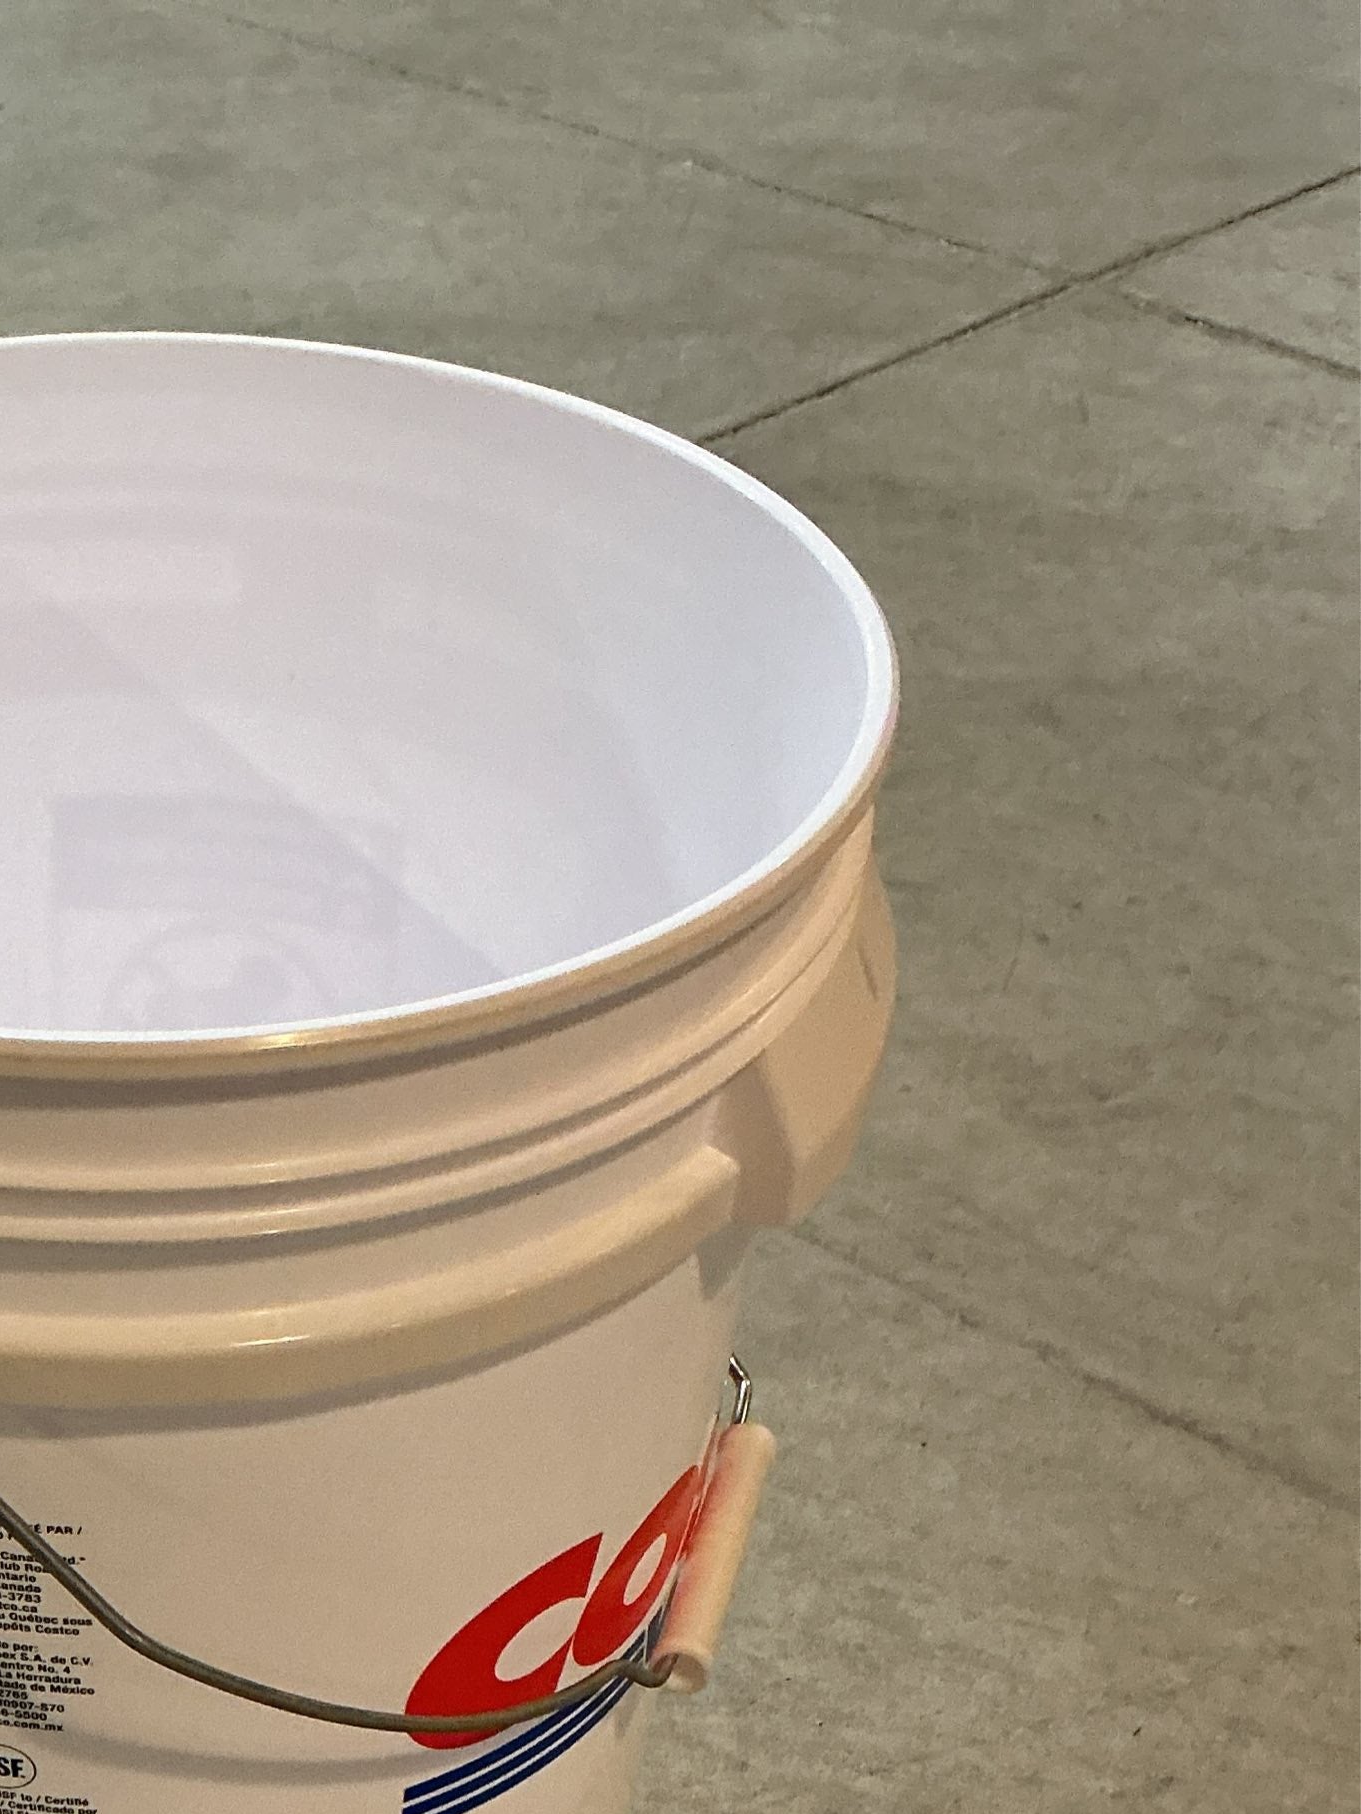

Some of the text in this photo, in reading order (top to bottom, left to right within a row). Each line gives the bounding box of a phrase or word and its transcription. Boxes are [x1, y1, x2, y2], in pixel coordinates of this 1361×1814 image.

[47, 1526, 73, 1534] PAR
[10, 1612, 58, 1624] Québec
[63, 1617, 93, 1625] sous
[36, 1625, 79, 1635] Costco
[51, 1655, 66, 1665] de
[38, 1661, 57, 1672] No.
[64, 1665, 70, 1674] 4
[17, 1672, 81, 1684] Herradura
[31, 1682, 46, 1692] de
[50, 1684, 95, 1694] México
[21, 1793, 33, 1802] to
[45, 1796, 89, 1806] Certifié
[8, 1801, 75, 1814] Certificado
